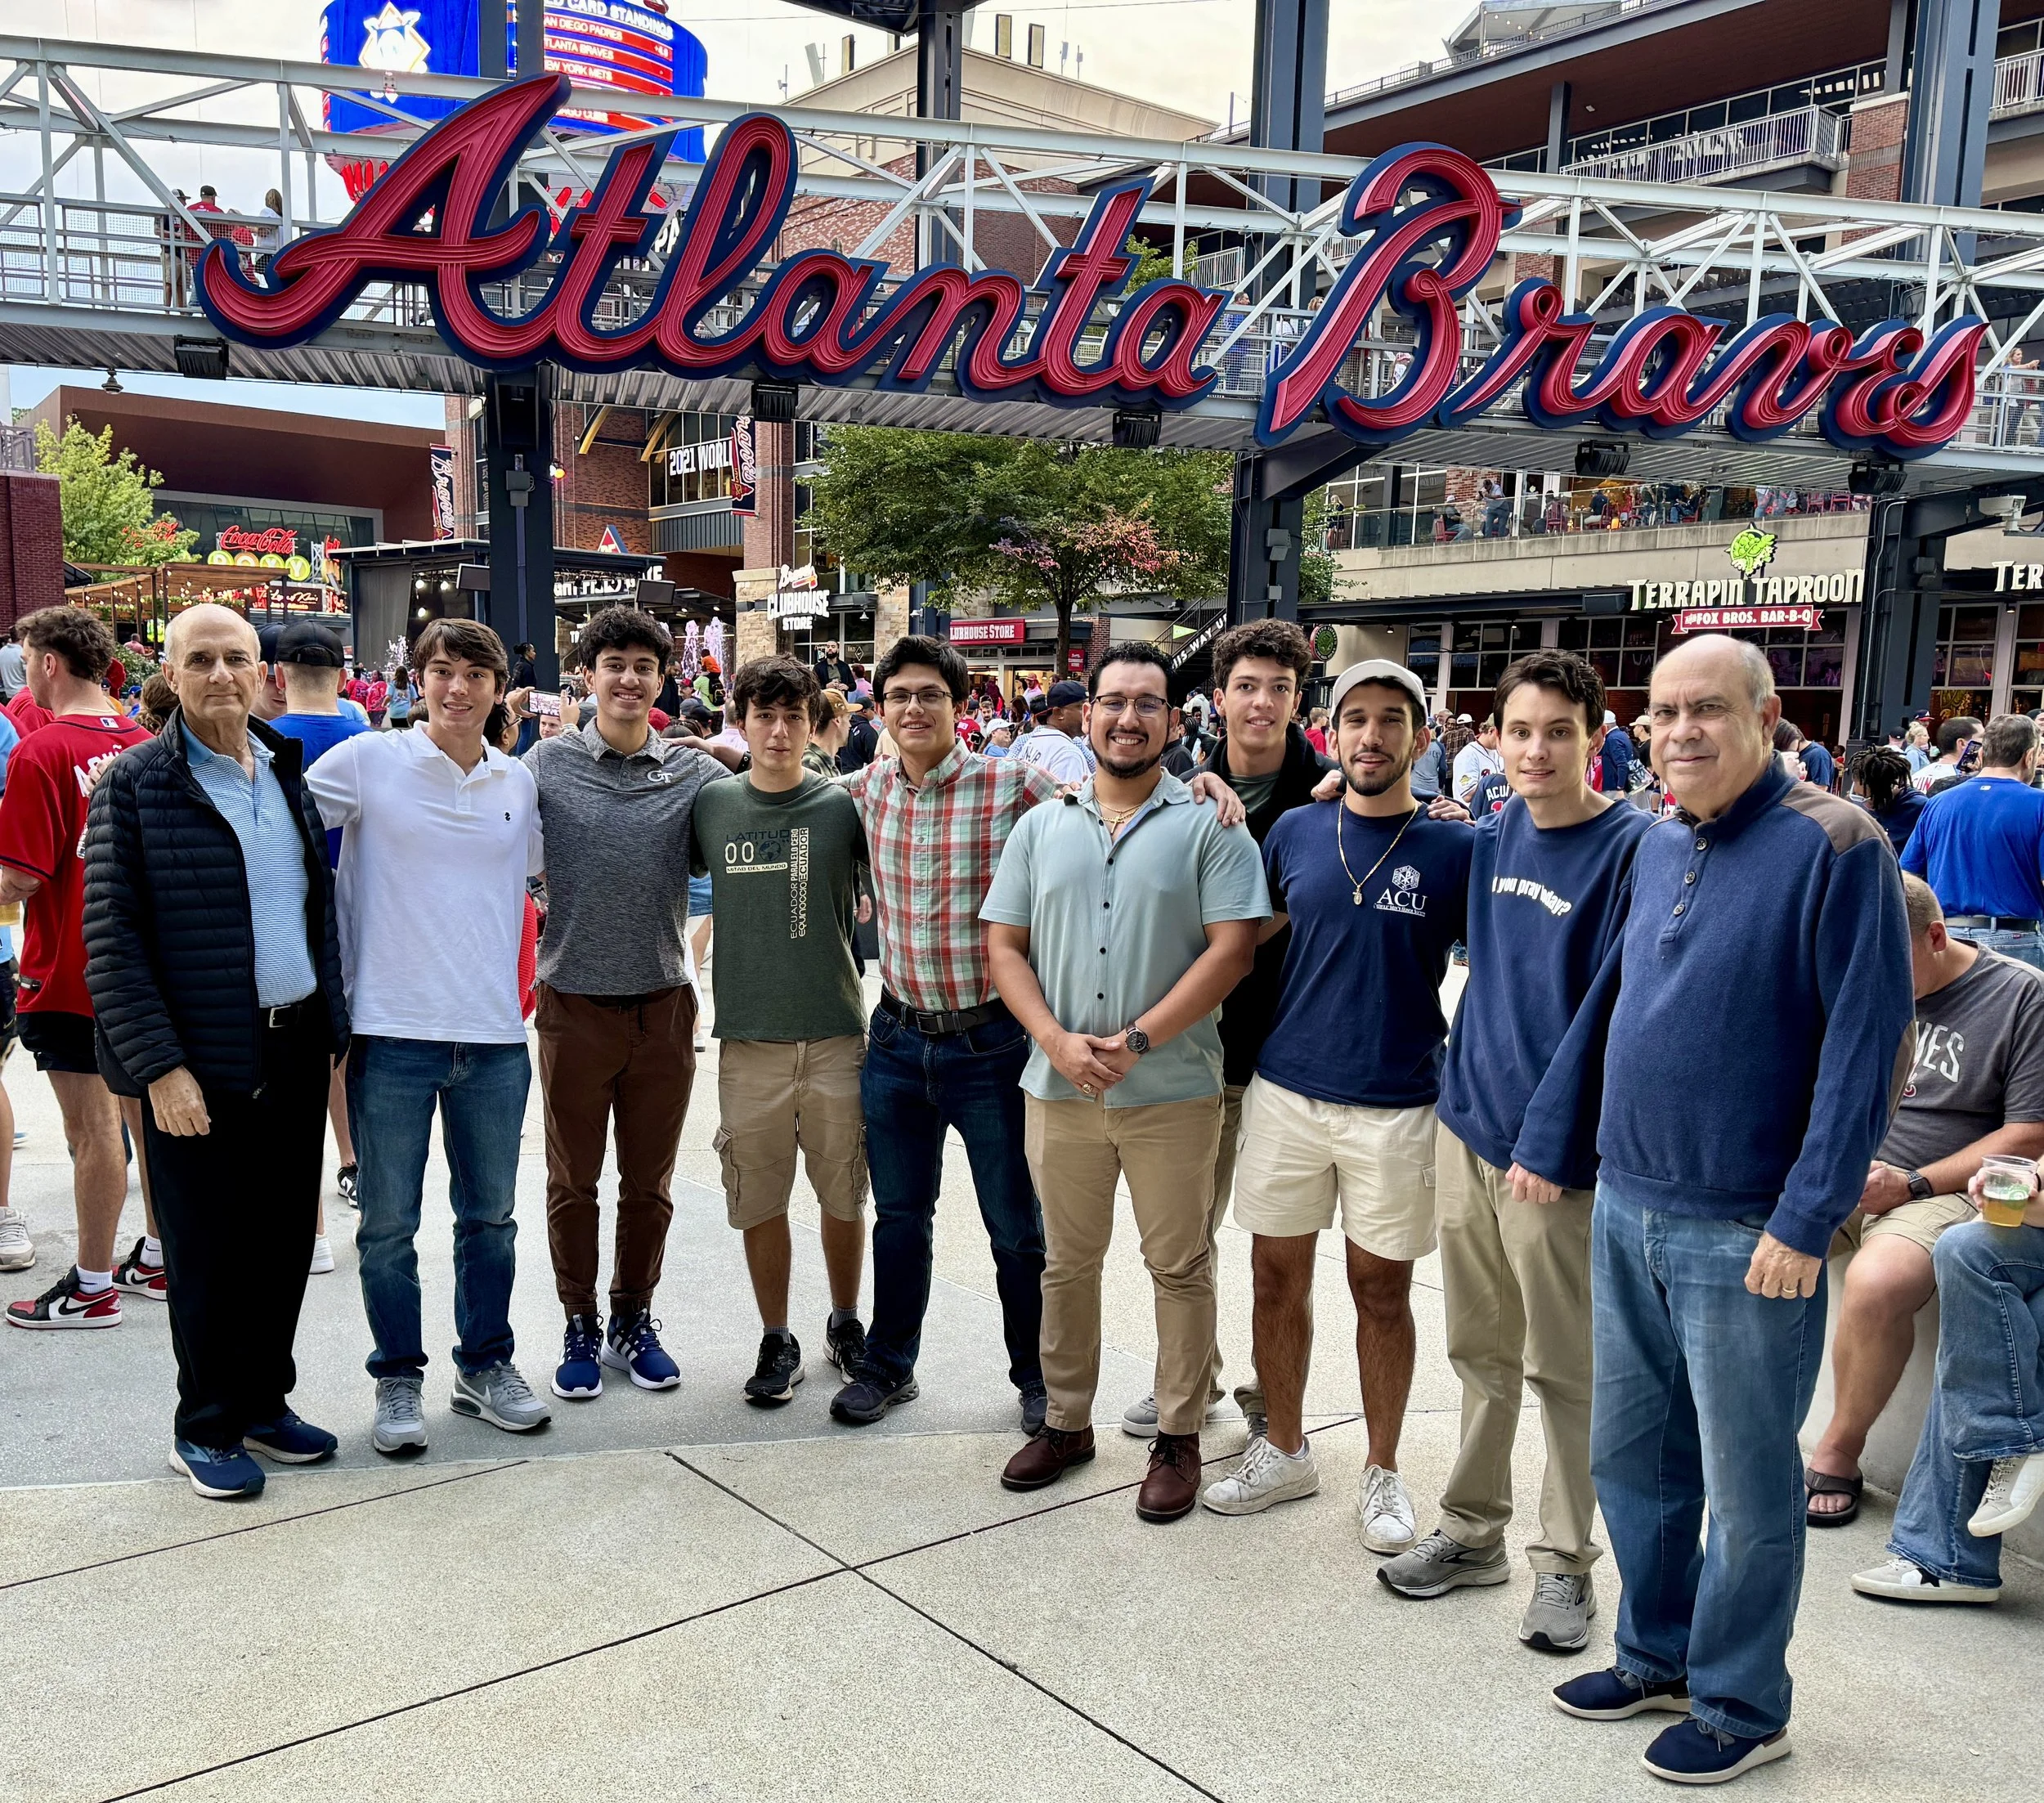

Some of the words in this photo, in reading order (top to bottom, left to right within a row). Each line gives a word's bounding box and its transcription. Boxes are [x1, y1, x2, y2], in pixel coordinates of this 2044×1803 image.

[545, 17, 557, 28] AN
[559, 18, 589, 33] DIEGO
[589, 25, 623, 40] PADRES
[610, 5, 674, 40] STANDINGS
[545, 38, 579, 52] TLANTA
[580, 43, 614, 60] BRAVES
[545, 60, 560, 72] EW
[563, 62, 587, 76] YORK
[589, 67, 612, 81] METS
[196, 74, 1231, 410] Atlanta
[1254, 141, 1991, 458] Braves
[670, 446, 697, 477] 2021
[736, 415, 756, 483] raves
[431, 453, 455, 528] Braves
[767, 590, 830, 621] CLUBHOUSE
[1626, 577, 1745, 611] TERRAPIN
[782, 616, 814, 631] STORE
[1696, 612, 1719, 625] FOX
[1722, 611, 1757, 625] BROS.
[1760, 609, 1812, 624] BAR-B-Q
[949, 626, 988, 640] LUBHOUSE
[989, 624, 1015, 639] STORE
[1190, 627, 1213, 652] WAY
[726, 830, 790, 842] LATITUD
[791, 828, 799, 845] CERO
[790, 847, 799, 881] PARALELO
[799, 827, 809, 881] ECUADOR
[761, 863, 787, 871] MUNDO
[1377, 888, 1428, 911] ACU
[1496, 877, 1518, 894] you
[1517, 879, 1541, 900] pray
[790, 882, 799, 940] ECUADOR
[1913, 1021, 1965, 1083] VES
